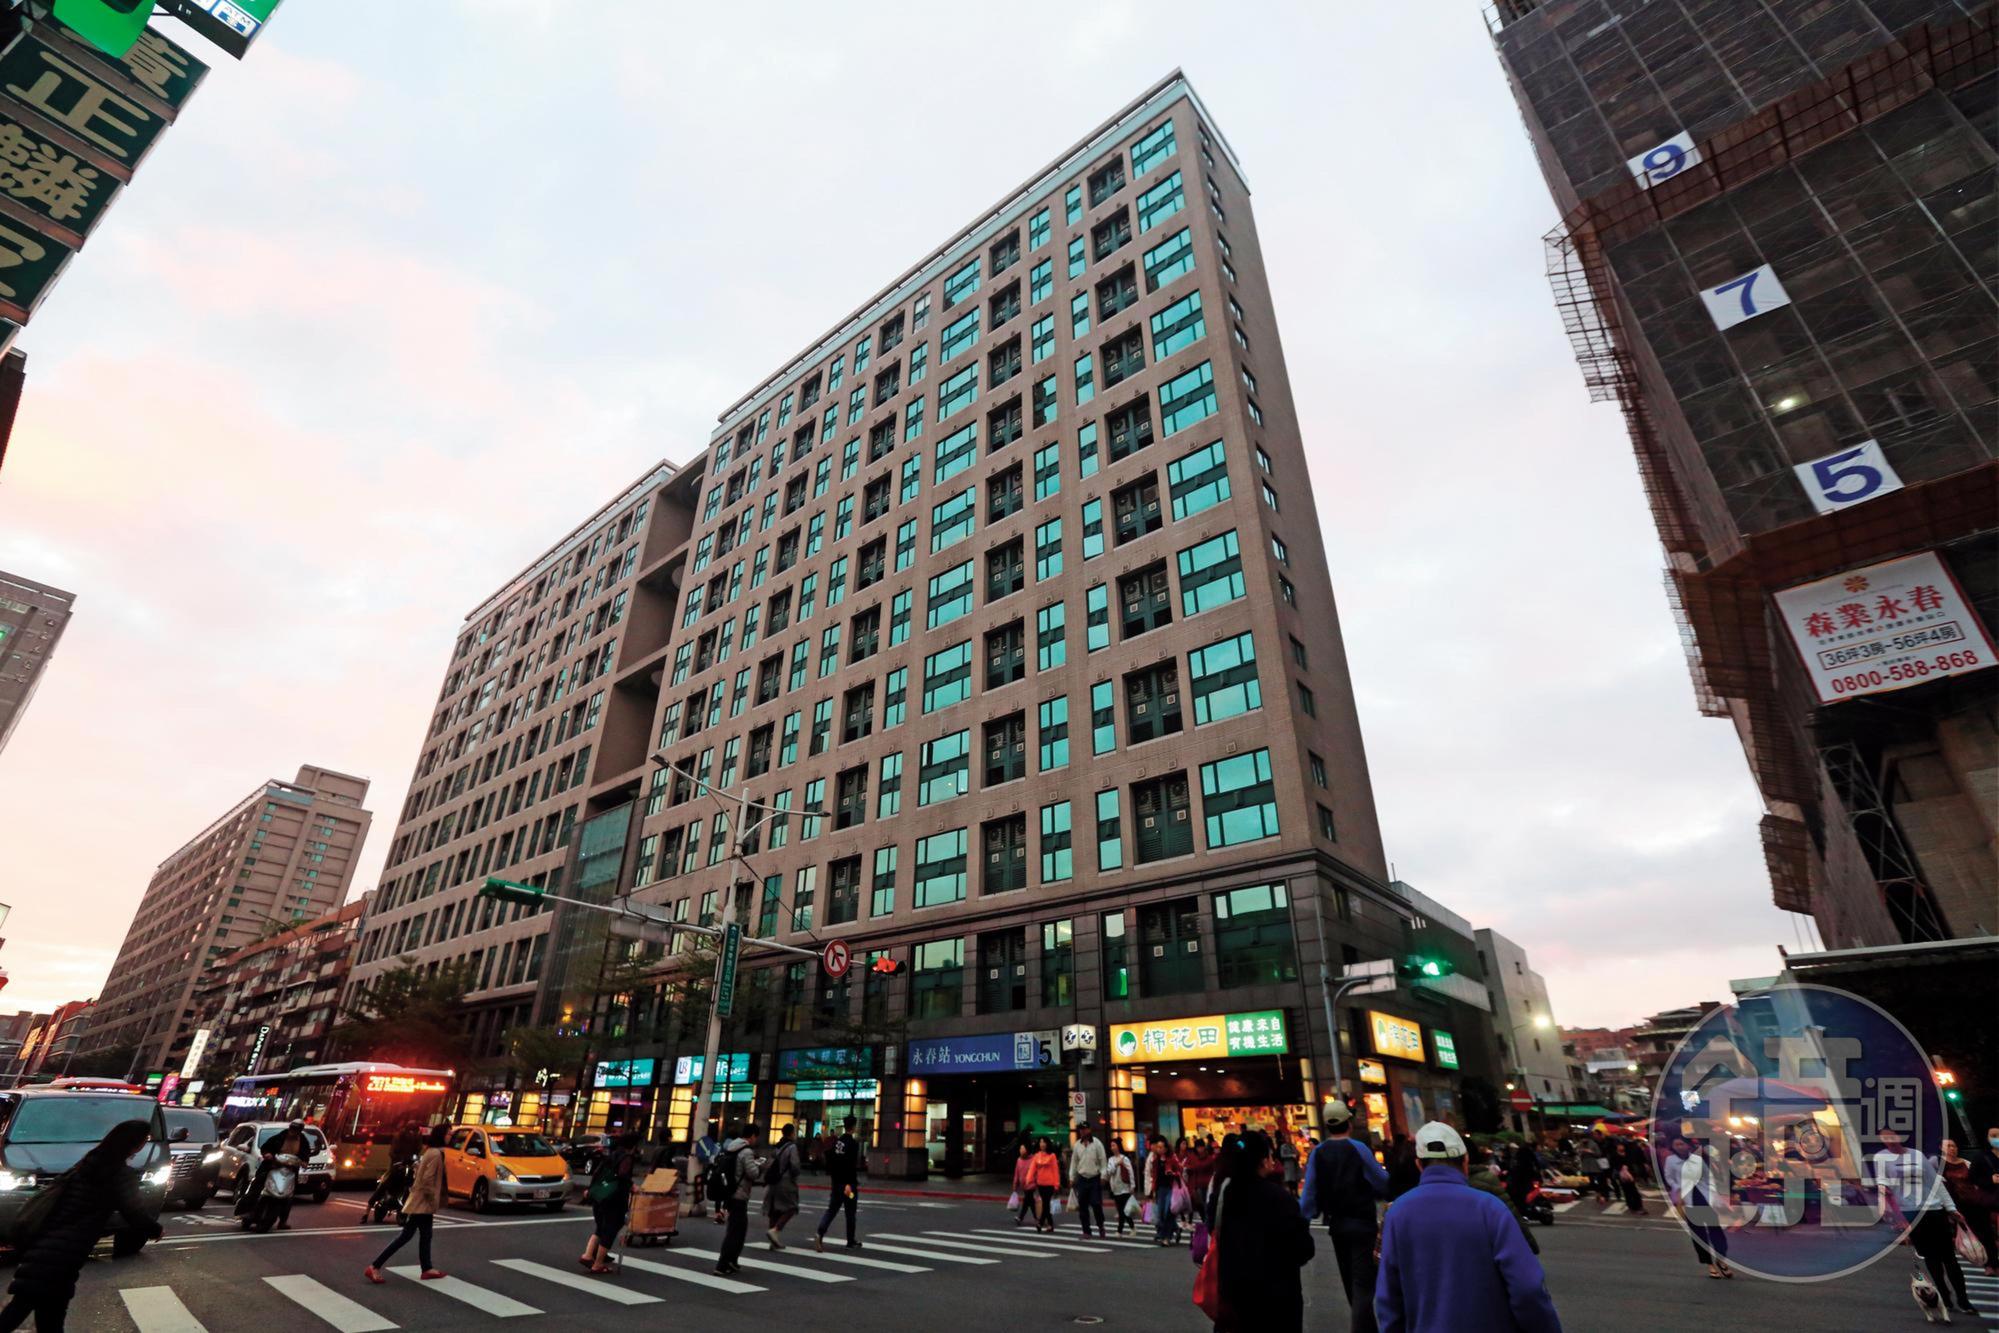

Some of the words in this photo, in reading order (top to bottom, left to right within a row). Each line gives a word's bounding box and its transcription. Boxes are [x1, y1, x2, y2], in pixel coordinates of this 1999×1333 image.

[1642, 143, 1687, 180] 9
[1714, 271, 1761, 317] 7
[1810, 444, 1883, 504] 5
[1803, 584, 1945, 638] 森業永春
[1832, 650, 1979, 694] 0800-588-868
[912, 1046, 950, 1065] 永春站
[954, 1051, 1000, 1065] YONGCHUN
[1038, 1040, 1052, 1066] 5
[1143, 1027, 1218, 1054] 棉花田
